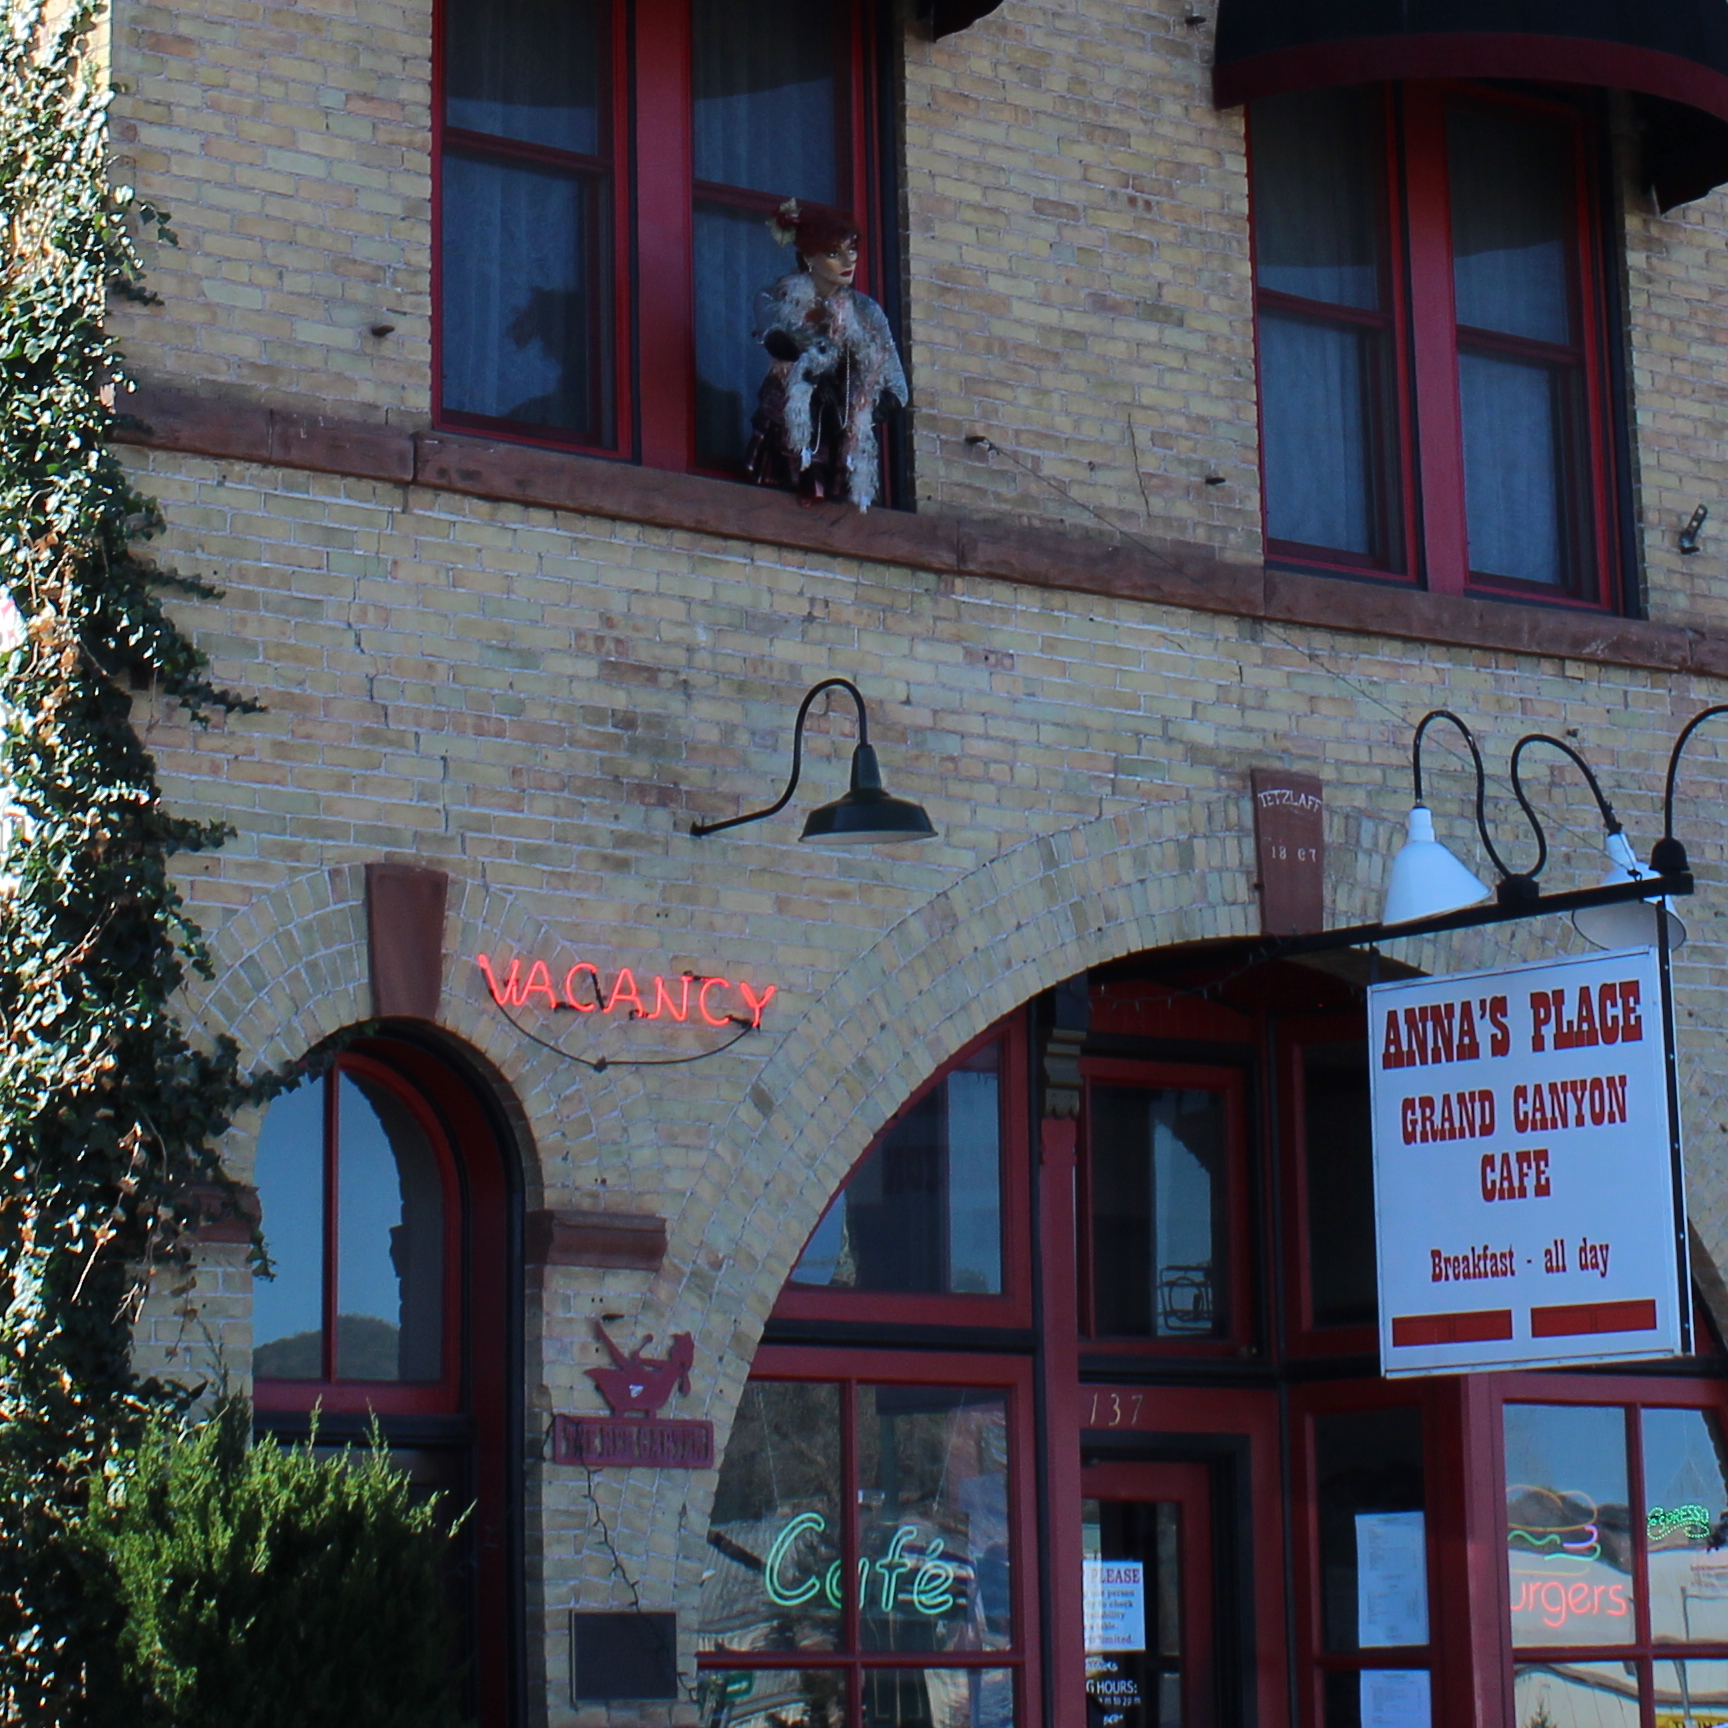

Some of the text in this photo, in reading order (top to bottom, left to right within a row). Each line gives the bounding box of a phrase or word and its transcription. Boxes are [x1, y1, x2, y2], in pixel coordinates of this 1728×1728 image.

[1257, 789, 1322, 813] TETZLAFF
[477, 953, 778, 1028] VACANCY
[1382, 979, 1643, 1070] ANNA'S PLACE
[1401, 1074, 1628, 1146] GRAND CANYON
[1480, 1148, 1552, 1203] CAFE
[1430, 1242, 1516, 1283] Breakfast
[1543, 1237, 1567, 1275] all
[1578, 1238, 1610, 1279] day
[1090, 1392, 1144, 1426] 137
[764, 1511, 955, 1615] Café
[1090, 1567, 1141, 1583] PLEASE
[1096, 1679, 1138, 1694] HOURS:
